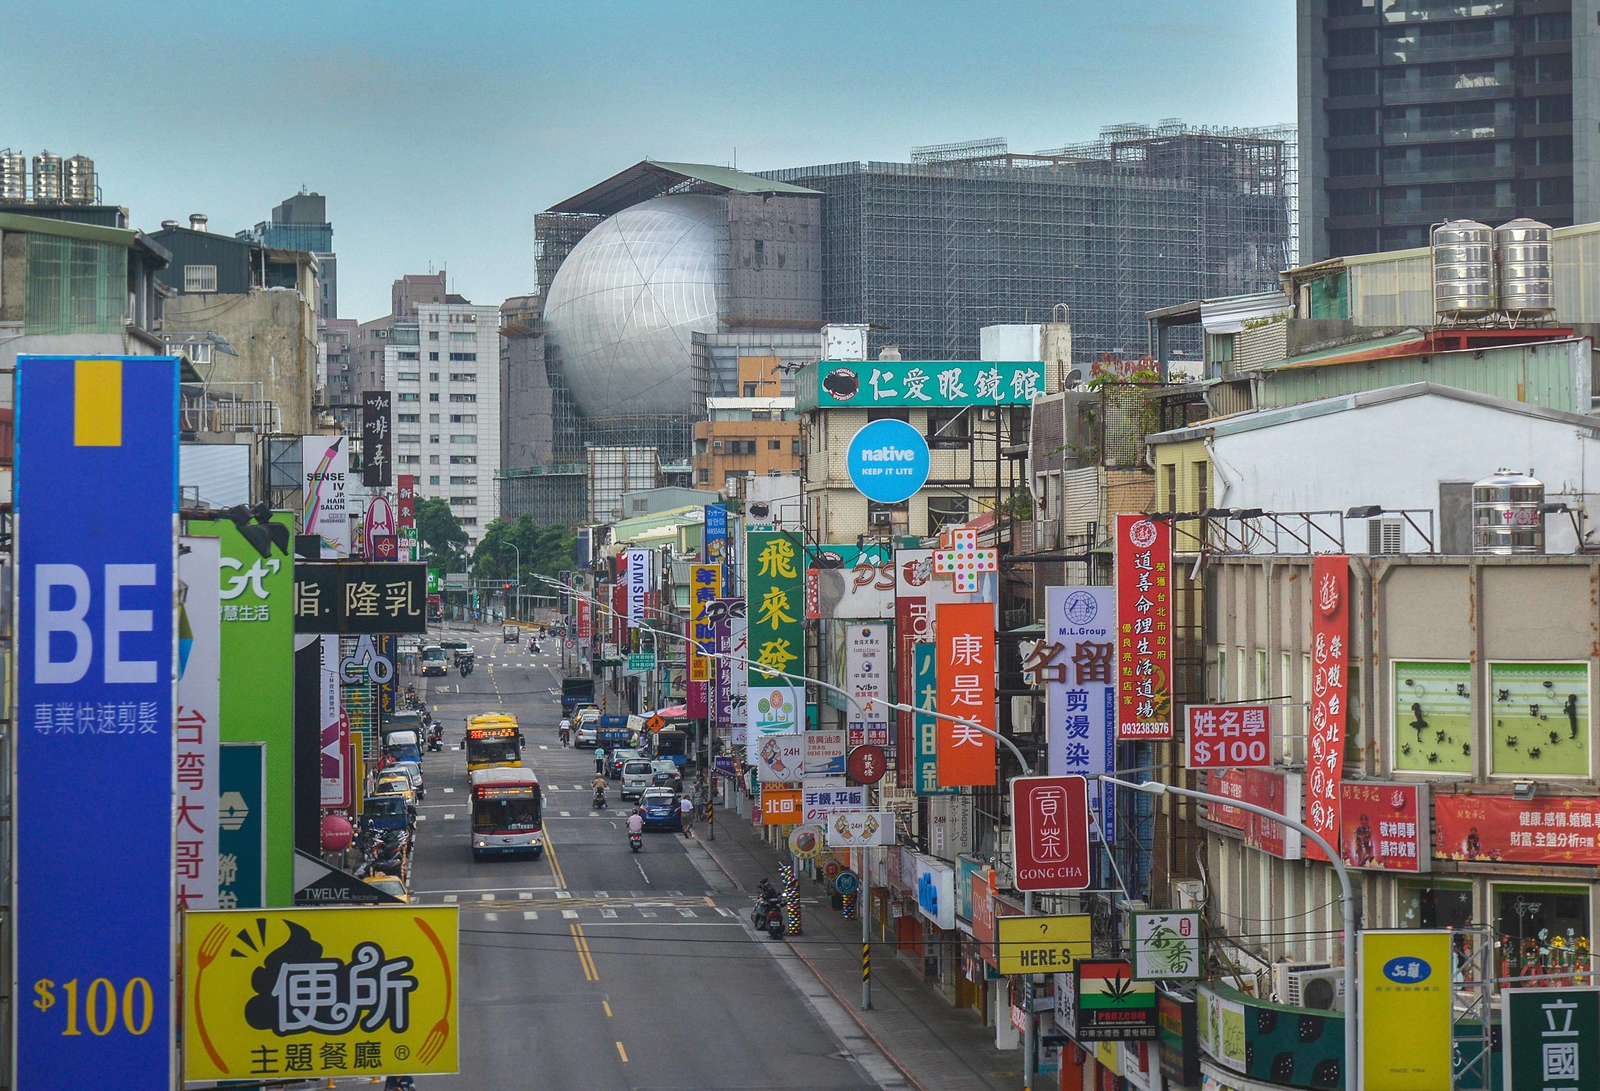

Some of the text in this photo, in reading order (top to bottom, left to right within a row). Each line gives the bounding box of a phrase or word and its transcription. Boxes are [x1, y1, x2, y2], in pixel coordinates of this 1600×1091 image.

[868, 367, 1041, 402] 仁愛眼鏡館
[862, 445, 914, 462] native
[307, 473, 345, 481] SENSE
[400, 487, 412, 528] 新東
[707, 527, 726, 535] MASSAGE
[34, 563, 158, 684] BE
[220, 605, 269, 621] 慧生活
[756, 538, 798, 680] 飛來發
[1059, 628, 1106, 636] M.L.Group
[1134, 551, 1154, 718] 道善命理生活道場
[1024, 639, 1113, 685] 名留
[948, 633, 984, 748] 康是美
[33, 702, 158, 734] 專業快速剪髮
[1065, 688, 1089, 777] 剪燙染
[1121, 723, 1169, 735] 0932383976
[1194, 709, 1265, 738] 姓名學
[783, 748, 800, 756] 24H
[1194, 740, 1266, 763] $100
[934, 816, 946, 824] 24H
[960, 808, 969, 848] Massage
[1020, 867, 1082, 879] GONG CHA
[305, 888, 350, 899] TWELVE
[1020, 949, 1071, 966] HERE.S
[271, 945, 413, 1033] 便所
[32, 976, 154, 1036] $100
[250, 1040, 383, 1074] 主題餐廳
[1541, 999, 1579, 1091] 立國
